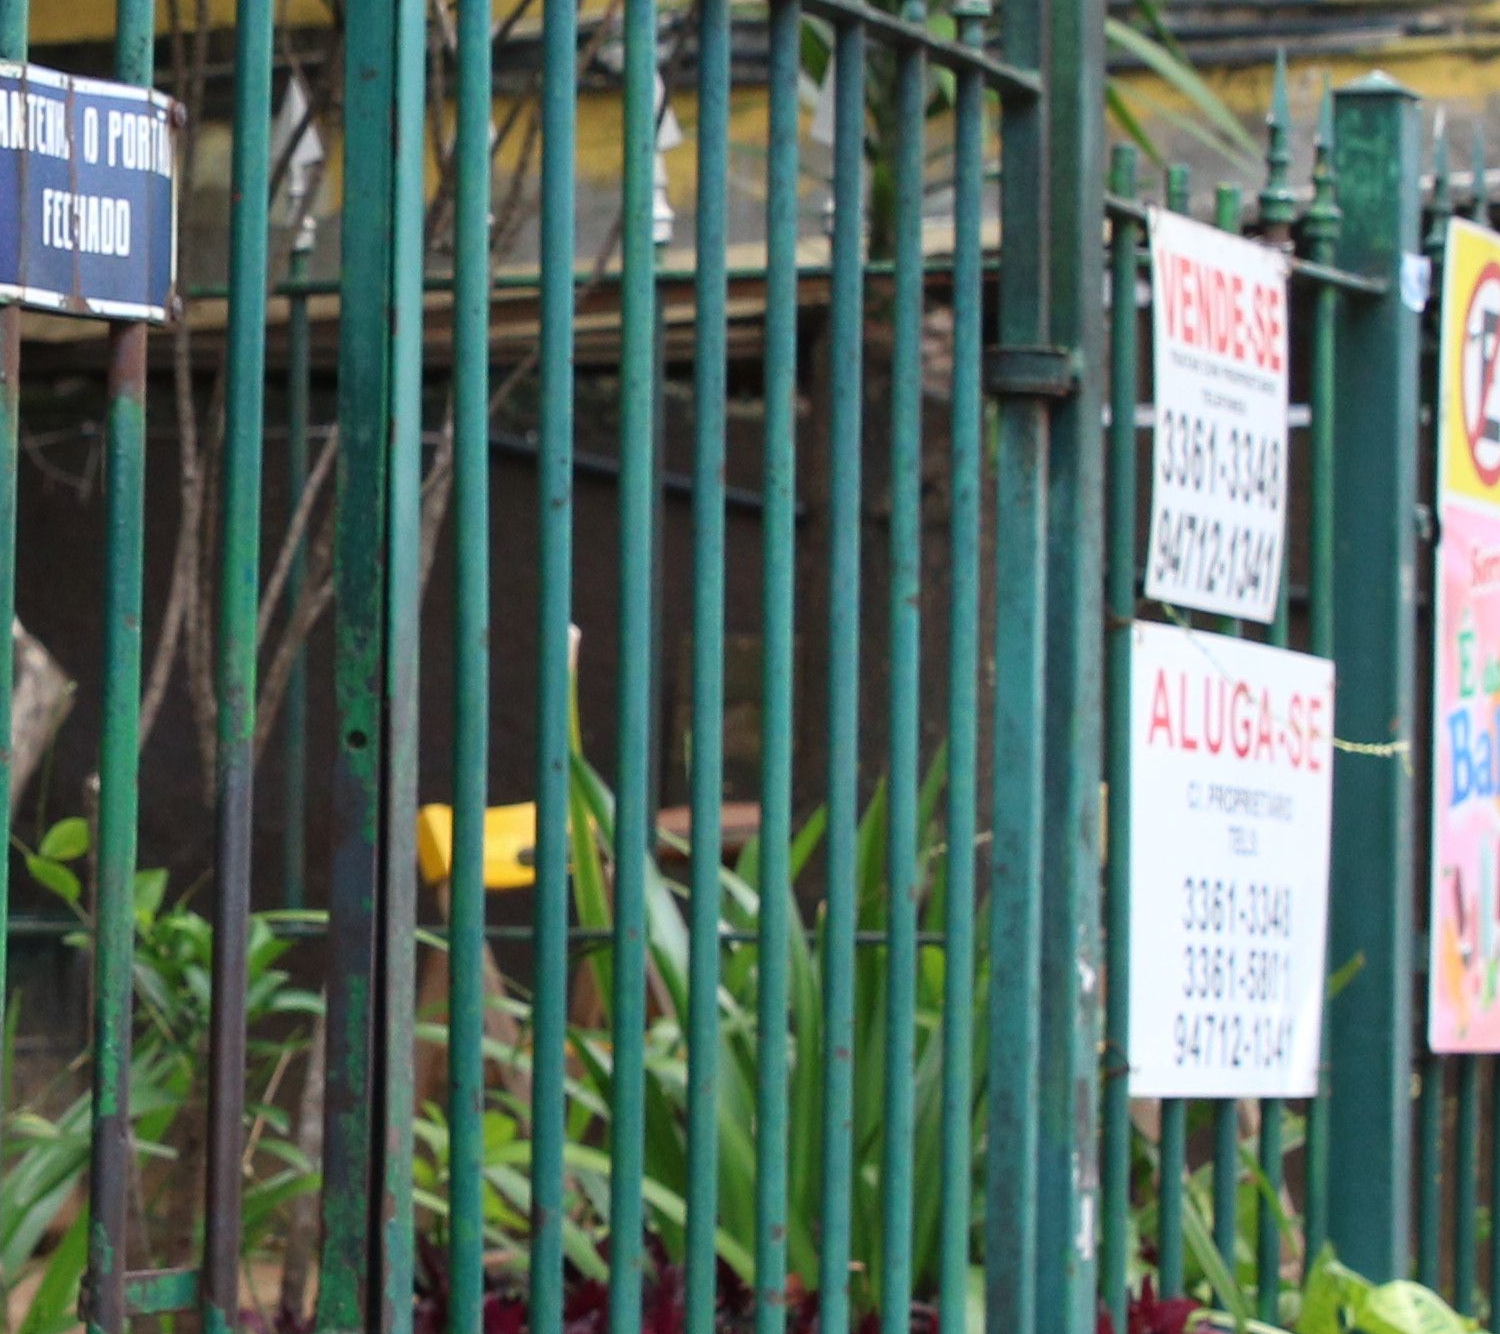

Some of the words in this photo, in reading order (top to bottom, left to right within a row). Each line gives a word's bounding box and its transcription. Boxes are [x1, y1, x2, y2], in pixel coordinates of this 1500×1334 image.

[83, 106, 99, 165] O
[43, 187, 131, 257] FECHADO
[1157, 248, 1281, 374] VENDE-SE
[1146, 667, 1323, 773] ALUGA-SE
